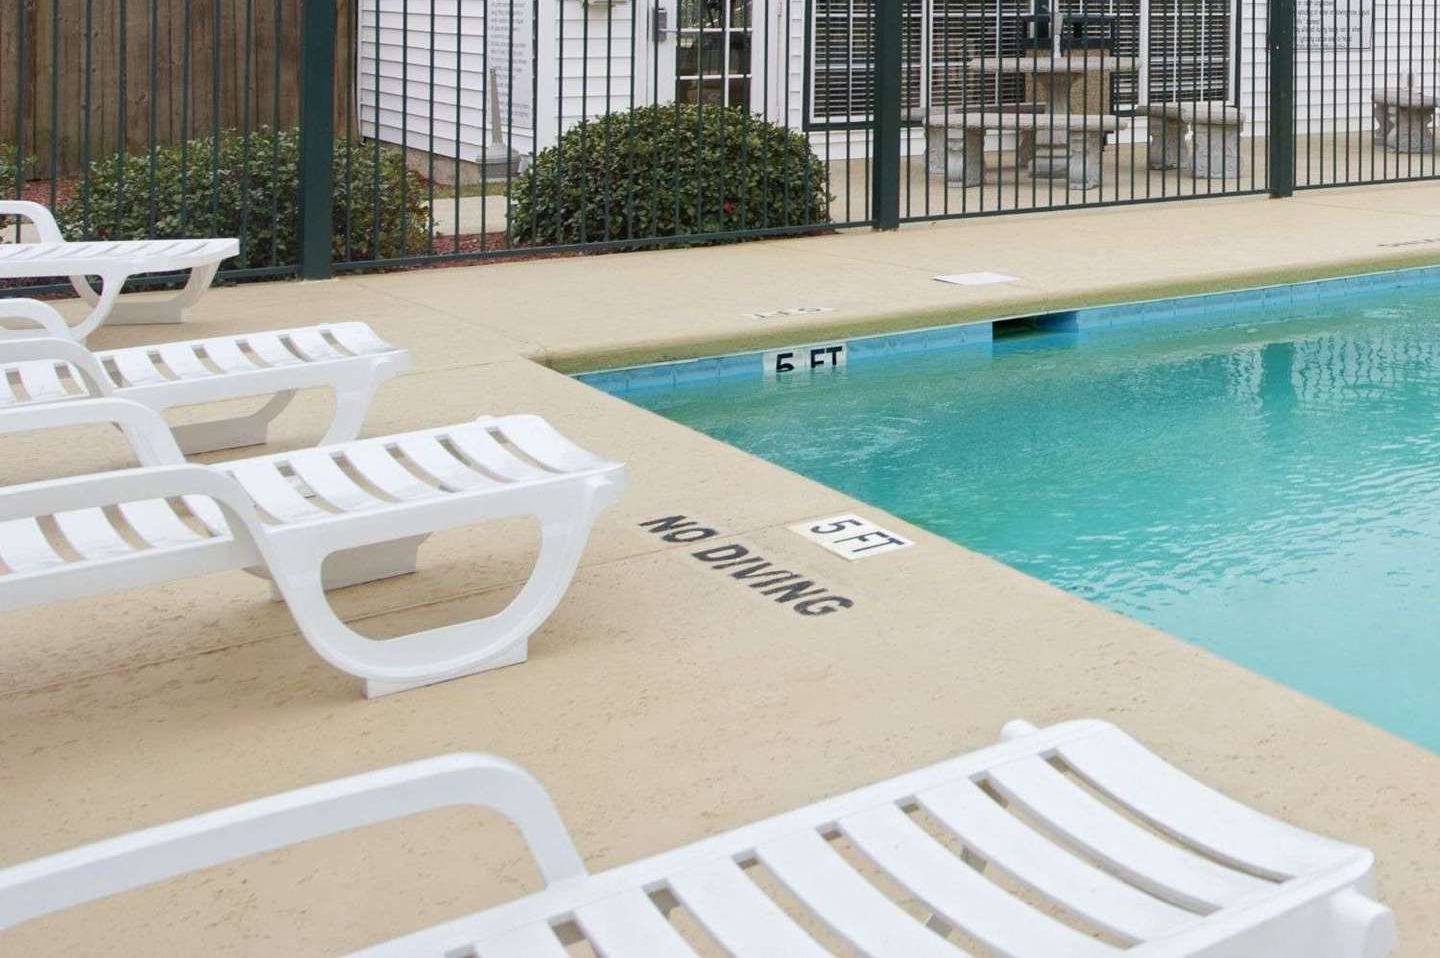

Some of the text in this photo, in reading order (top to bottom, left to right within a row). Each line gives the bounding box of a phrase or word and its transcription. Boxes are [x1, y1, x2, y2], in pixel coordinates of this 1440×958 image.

[776, 346, 843, 373] 5 FT
[810, 518, 905, 553] 5 FT
[639, 514, 856, 617] NO DIVING
